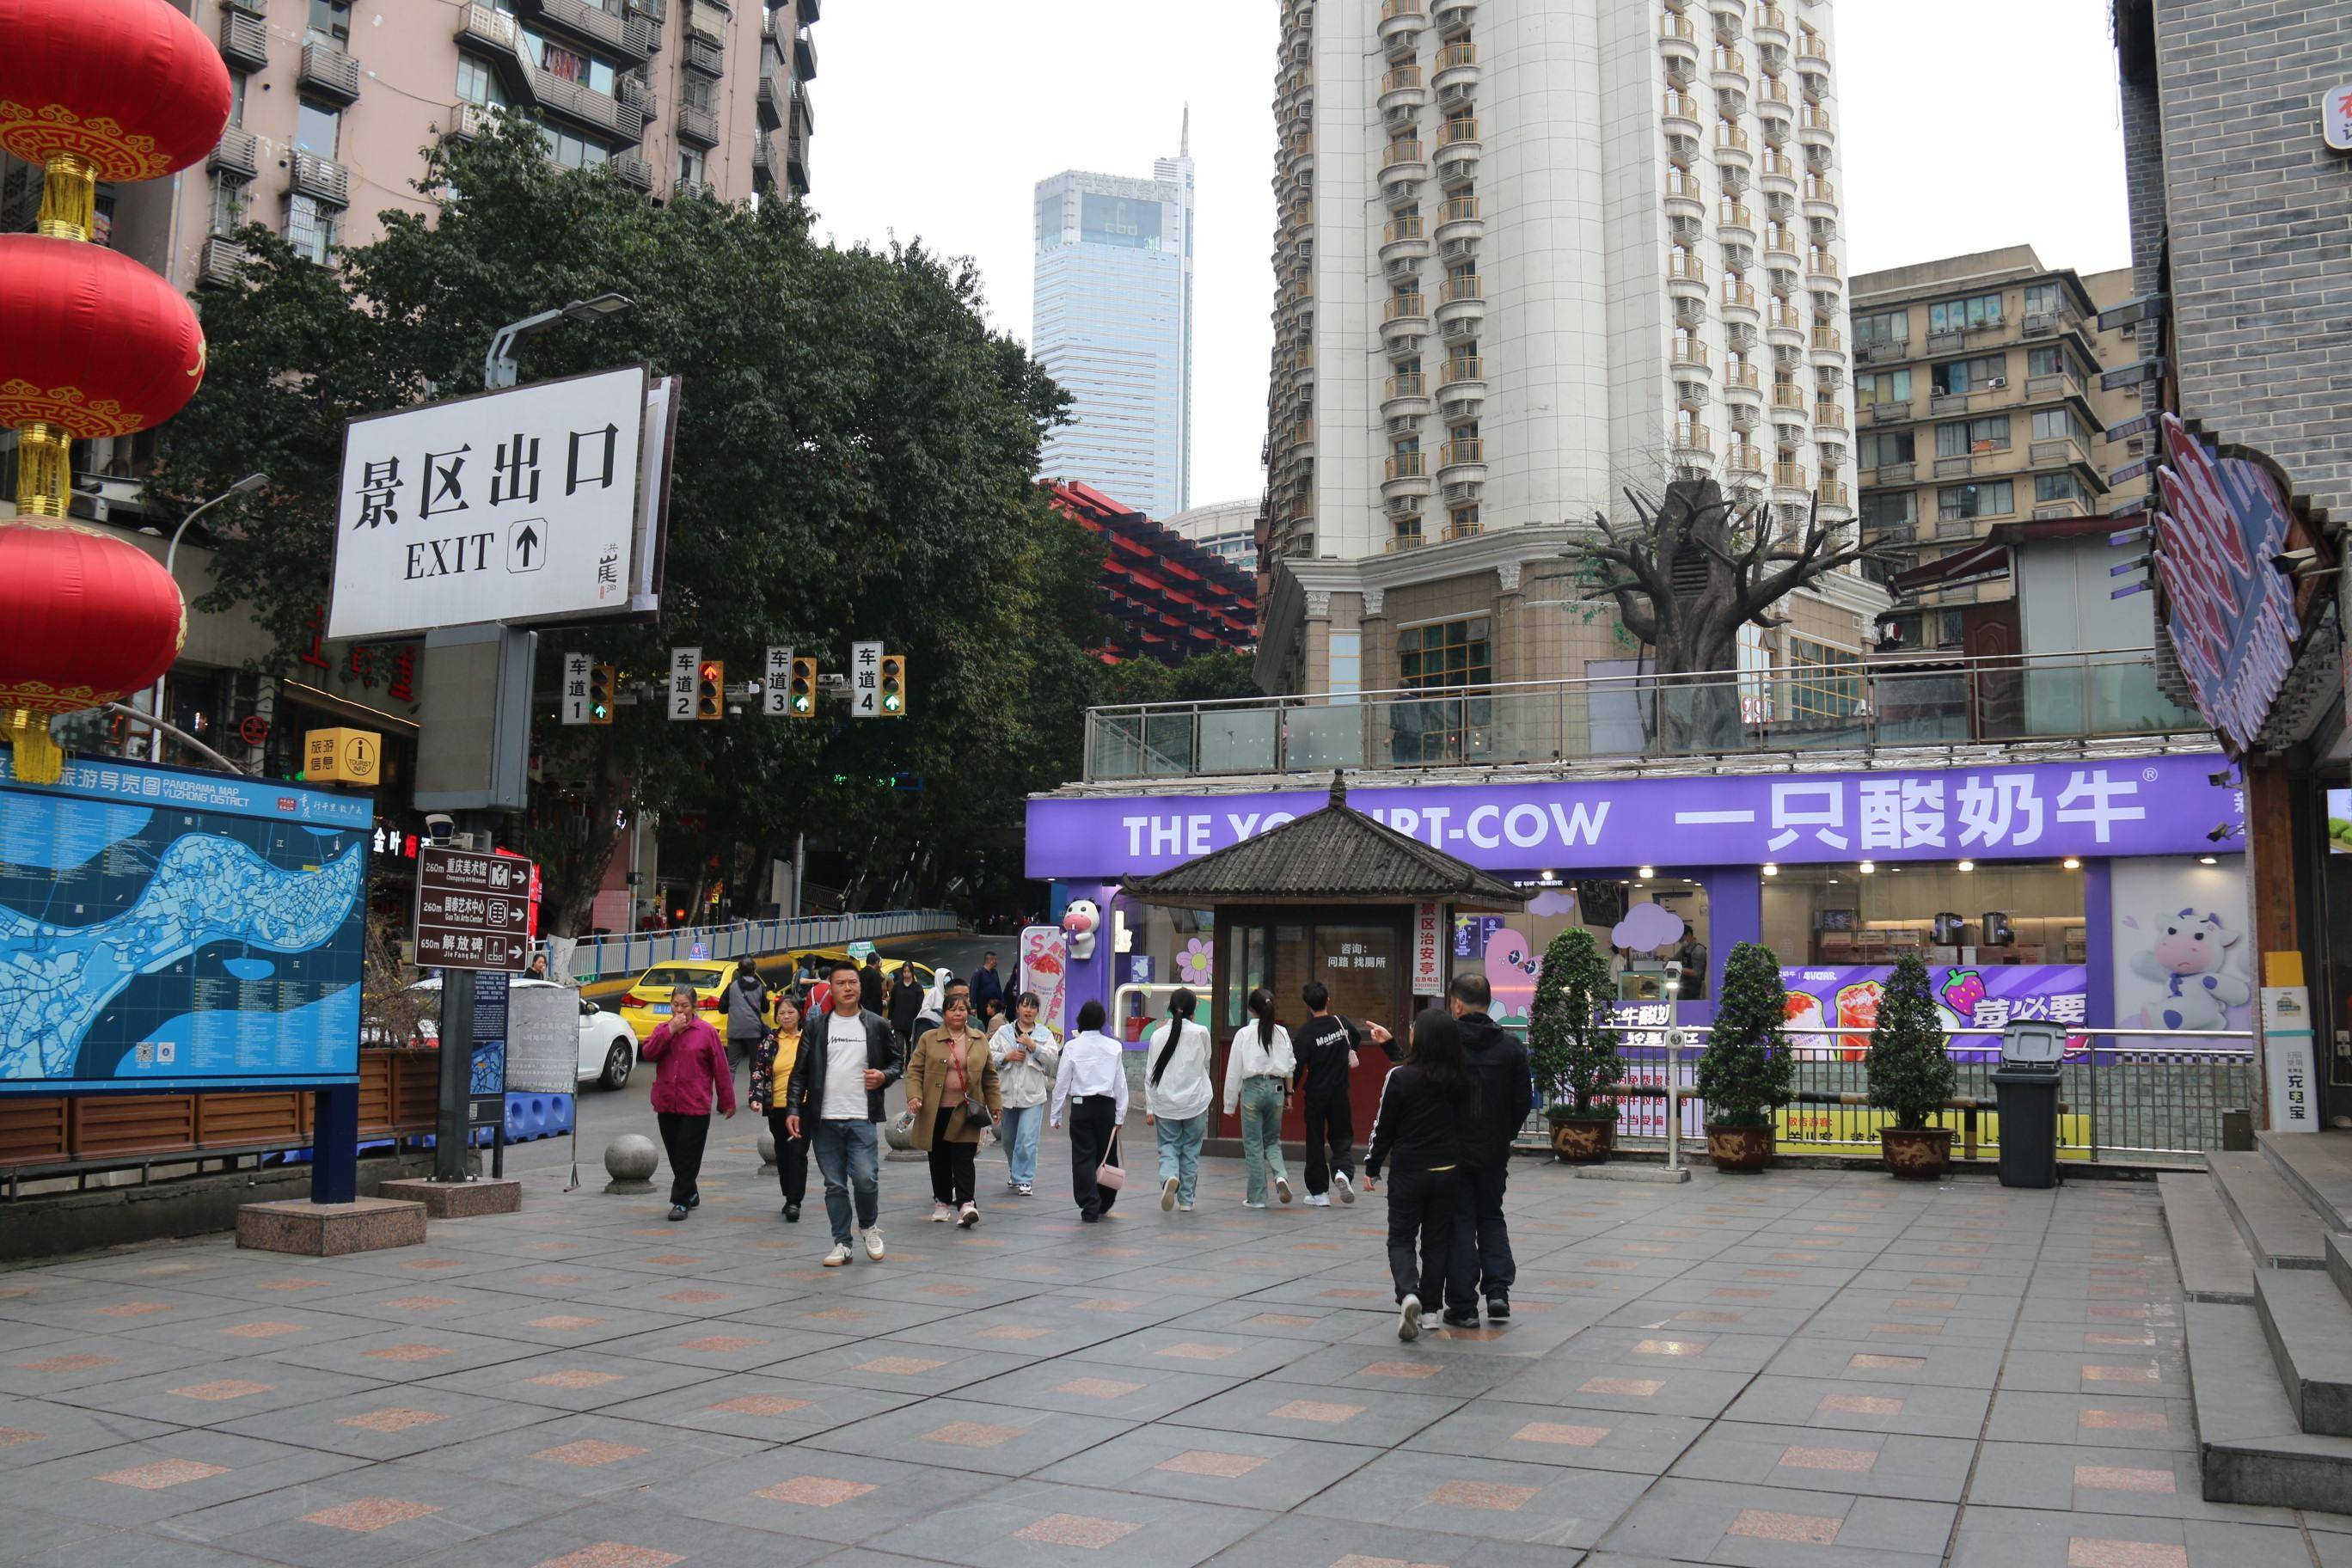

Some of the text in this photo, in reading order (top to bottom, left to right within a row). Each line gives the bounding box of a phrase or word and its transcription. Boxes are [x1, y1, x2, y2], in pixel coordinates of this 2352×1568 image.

[352, 422, 619, 531] 景区出口
[403, 531, 495, 581] EXIT
[311, 739, 334, 754] 旅游
[310, 756, 334, 771] 信息
[348, 758, 371, 768] TOURIST
[162, 779, 240, 797] PANORAMA MAP
[162, 788, 250, 807] YUZHONG DISTRICT
[1675, 769, 2146, 852] 一只酸奶牛
[1123, 800, 1611, 856] THE YORT-COW
[426, 858, 487, 876] 260m 重庆美术馆
[423, 896, 486, 915] 260m 国泰艺术中心
[420, 934, 483, 952] 650m 解放碑
[1419, 903, 1436, 975] 景区治安亭
[1327, 956, 1387, 968] 问路 找厕所
[2288, 1075, 2306, 1119] 充电宝
